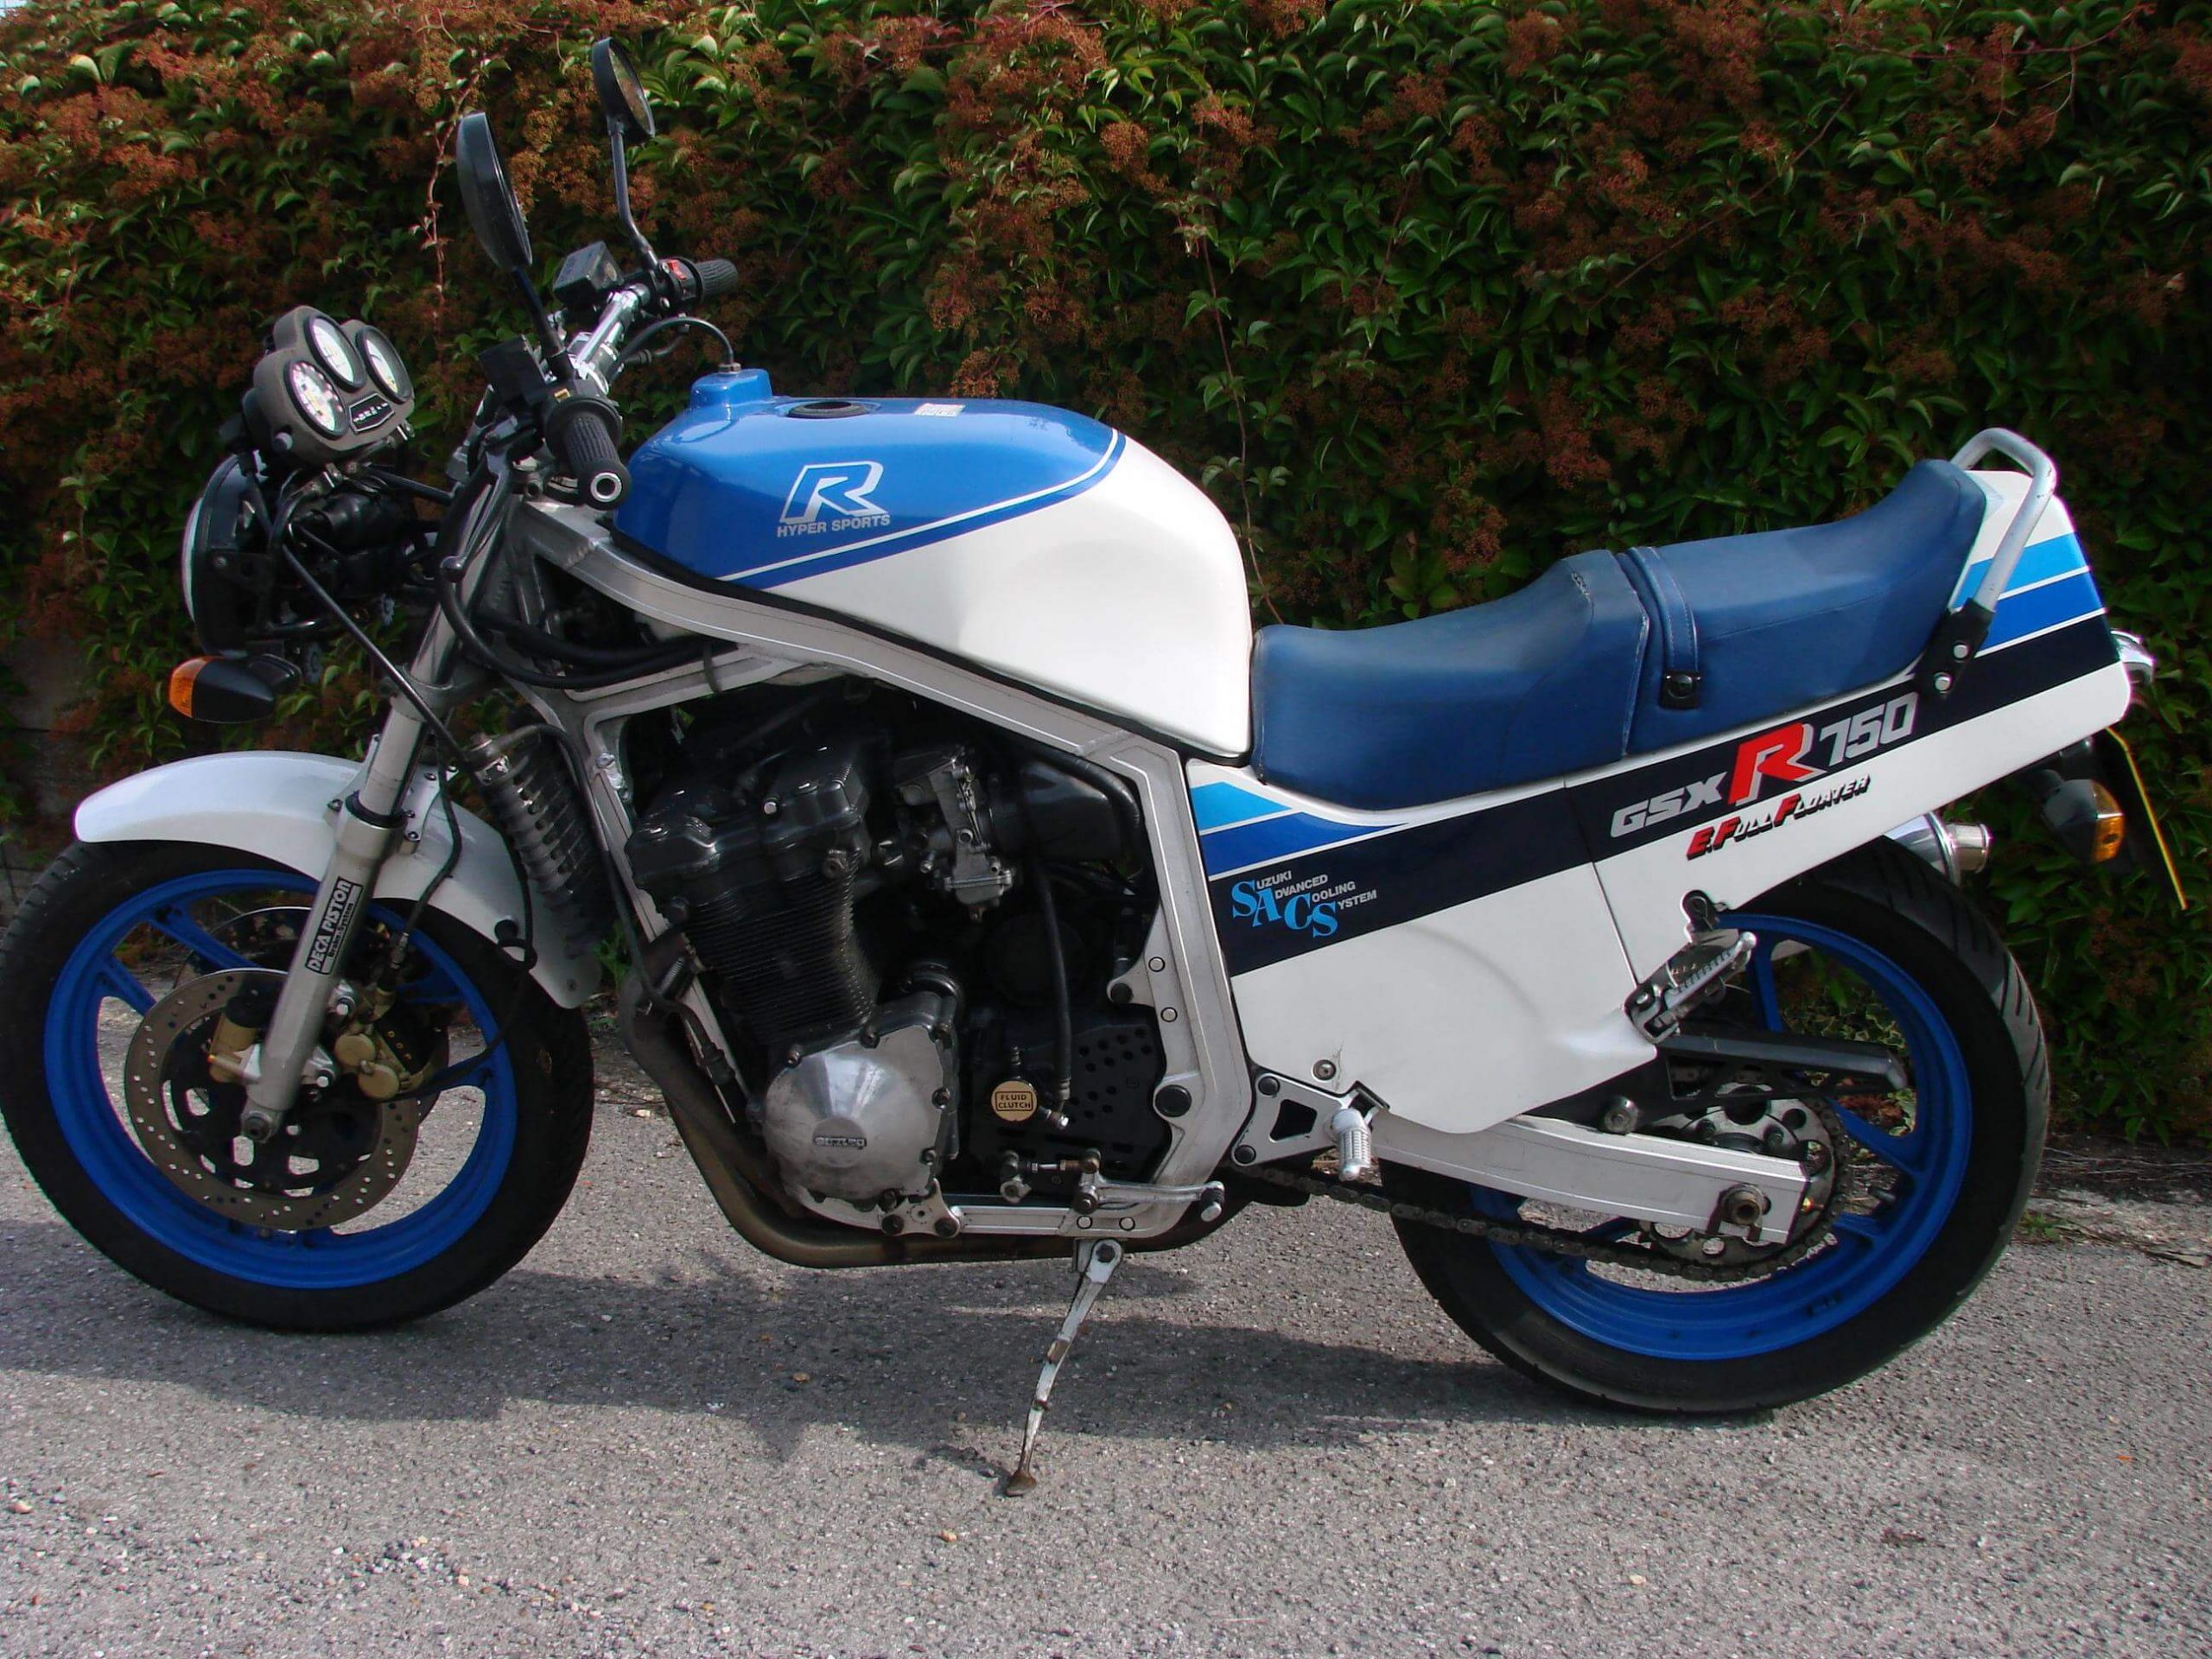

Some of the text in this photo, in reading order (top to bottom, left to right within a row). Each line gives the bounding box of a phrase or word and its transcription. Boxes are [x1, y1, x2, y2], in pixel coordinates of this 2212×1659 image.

[777, 514, 891, 538] HYPER SPORTS
[1819, 691, 1919, 766] 750
[1774, 774, 1871, 828] FLOATER
[308, 934, 331, 971] DECA
